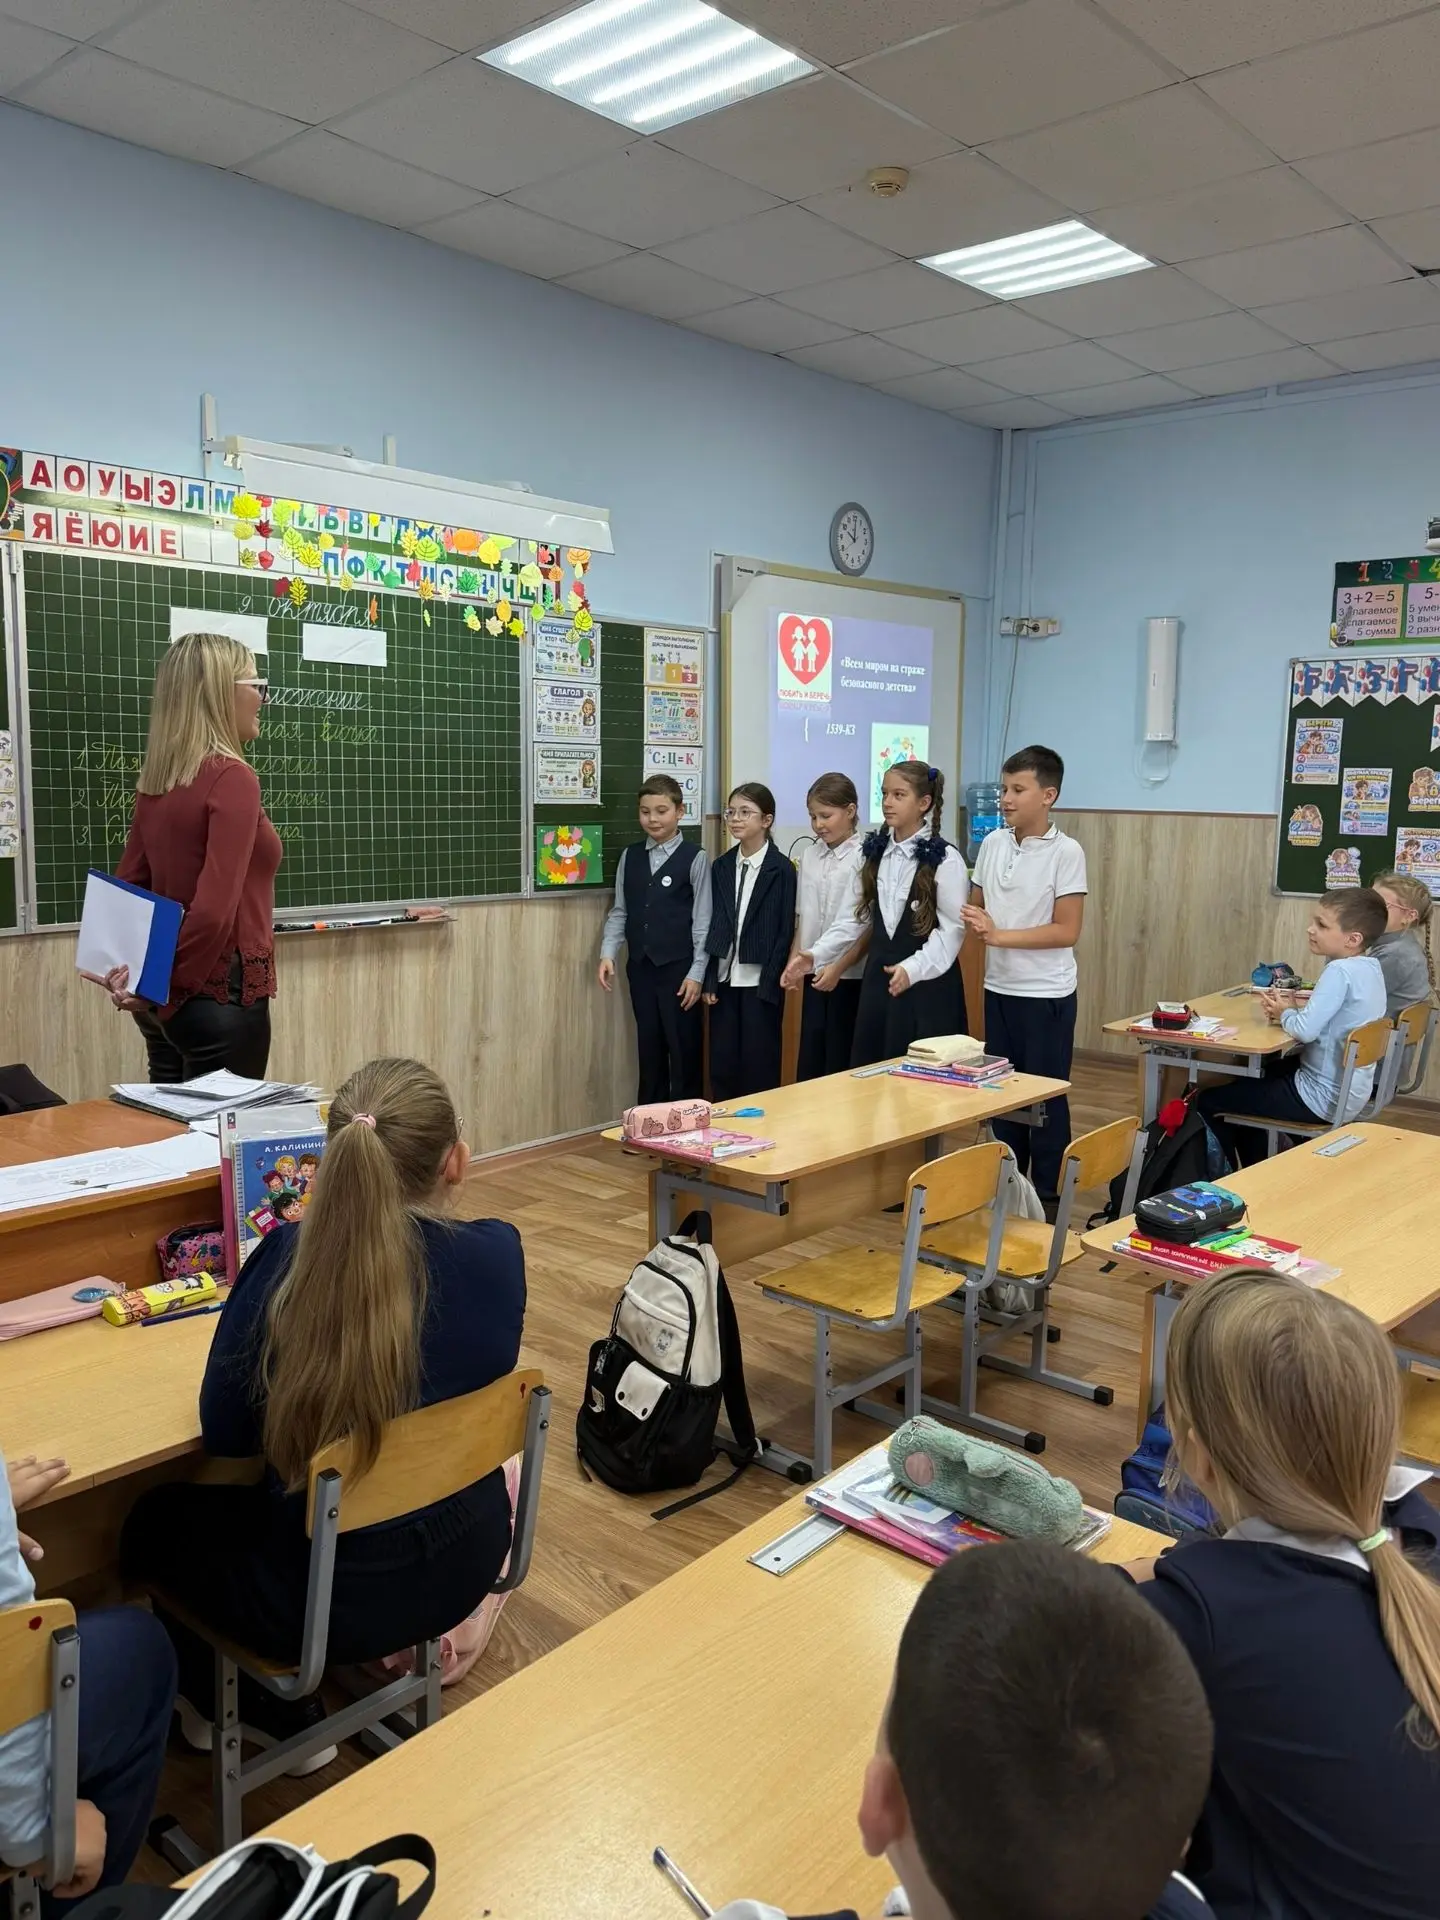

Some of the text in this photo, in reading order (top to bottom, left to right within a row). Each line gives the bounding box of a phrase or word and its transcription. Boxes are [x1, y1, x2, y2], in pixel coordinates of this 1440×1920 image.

[1349, 606, 1399, 616] лагаемое
[1409, 605, 1415, 613] 5
[1408, 614, 1414, 623] 3
[1365, 627, 1397, 637] сумма
[1407, 625, 1414, 634] 2
[553, 688, 581, 697] ГЛАГОЛ
[268, 687, 375, 711] ложение.
[1411, 796, 1440, 806] Берег
